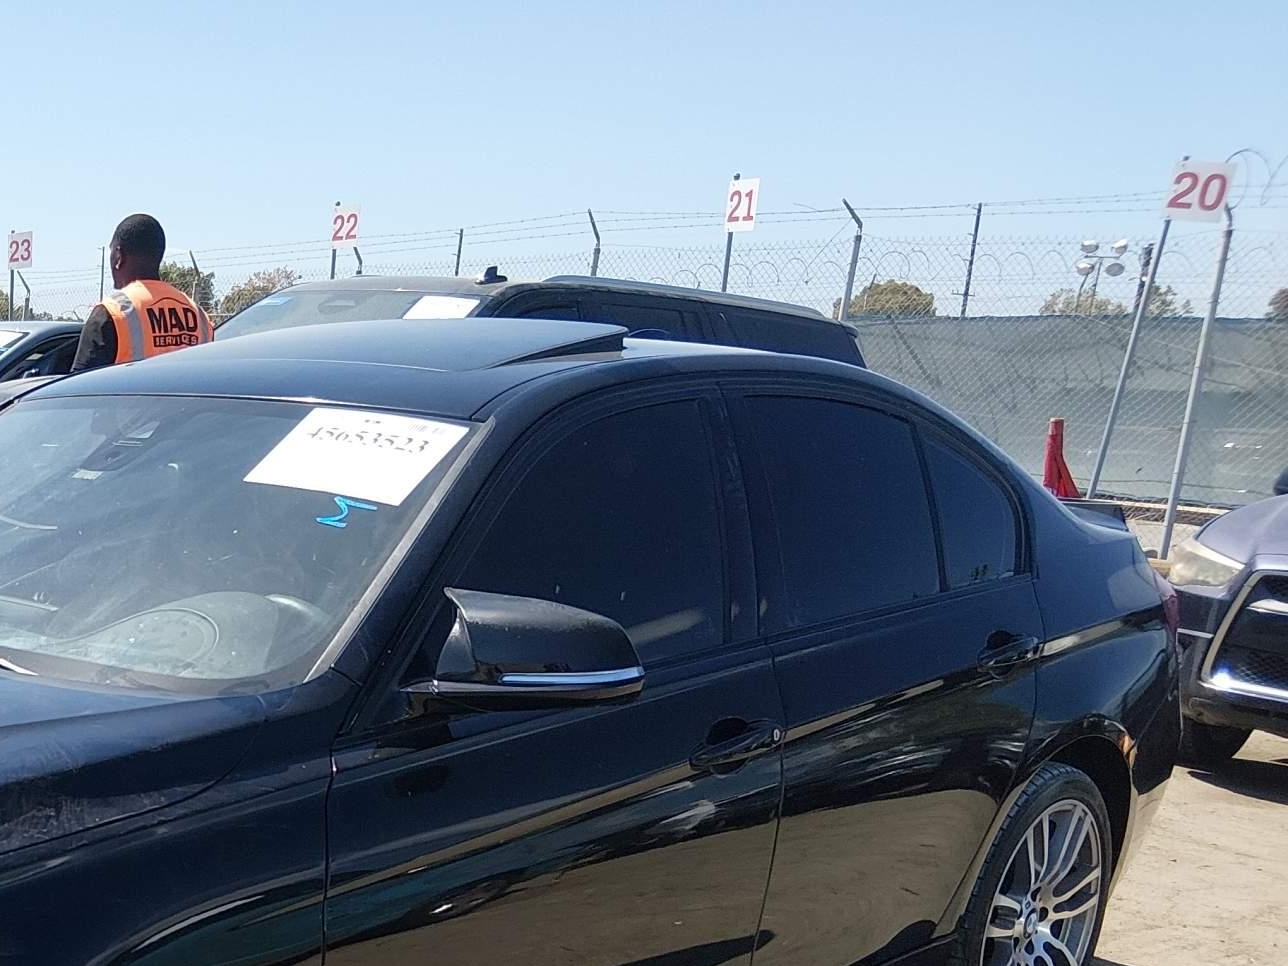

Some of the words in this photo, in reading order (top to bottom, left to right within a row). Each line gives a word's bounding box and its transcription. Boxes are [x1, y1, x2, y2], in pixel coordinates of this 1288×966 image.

[1166, 171, 1227, 211] 20
[727, 189, 753, 222] 21
[332, 213, 358, 241] 22
[9, 238, 31, 263] 23
[146, 306, 199, 334] MAD
[154, 334, 198, 346] SERVICES
